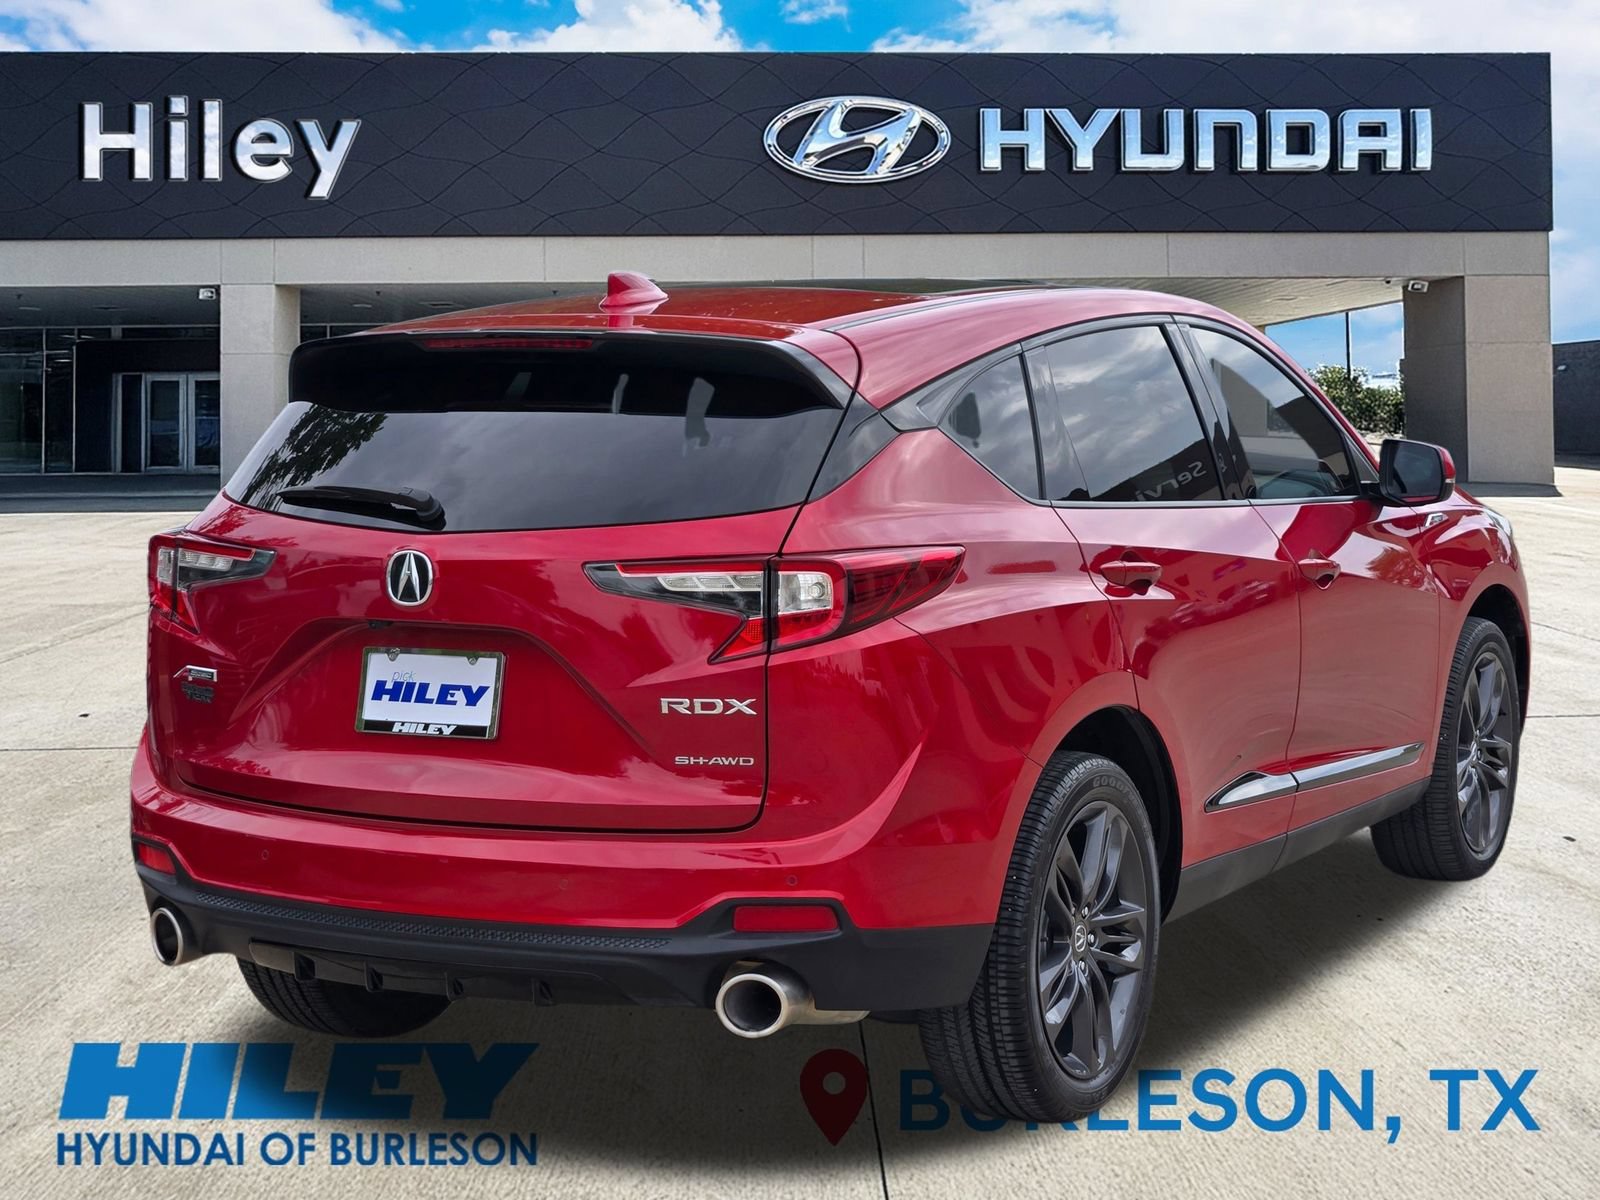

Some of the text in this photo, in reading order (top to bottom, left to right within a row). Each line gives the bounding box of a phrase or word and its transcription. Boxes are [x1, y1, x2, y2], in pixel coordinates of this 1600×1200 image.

[80, 96, 362, 200] Hiley
[979, 108, 1433, 172] HYUNDAI
[371, 679, 490, 706] HILEY
[660, 697, 758, 715] RDX
[391, 721, 458, 735] HILEY
[674, 756, 755, 766] SH-AWD
